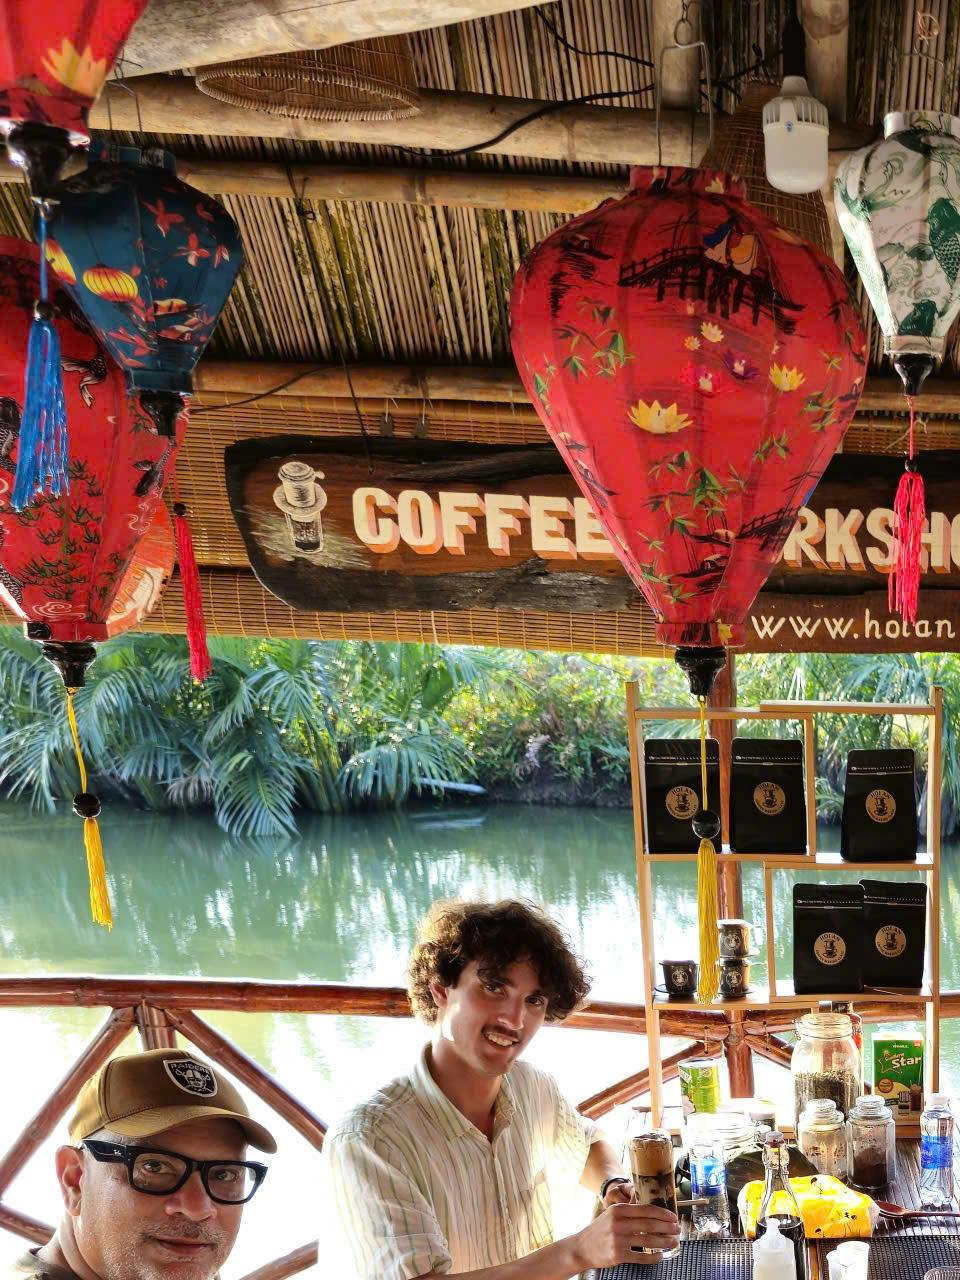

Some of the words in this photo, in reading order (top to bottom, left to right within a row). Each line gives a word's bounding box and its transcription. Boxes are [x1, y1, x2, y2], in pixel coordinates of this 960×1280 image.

[352, 486, 620, 560] COFFEE
[170, 1062, 211, 1075] RAIDERS
[891, 1056, 922, 1069] Star
